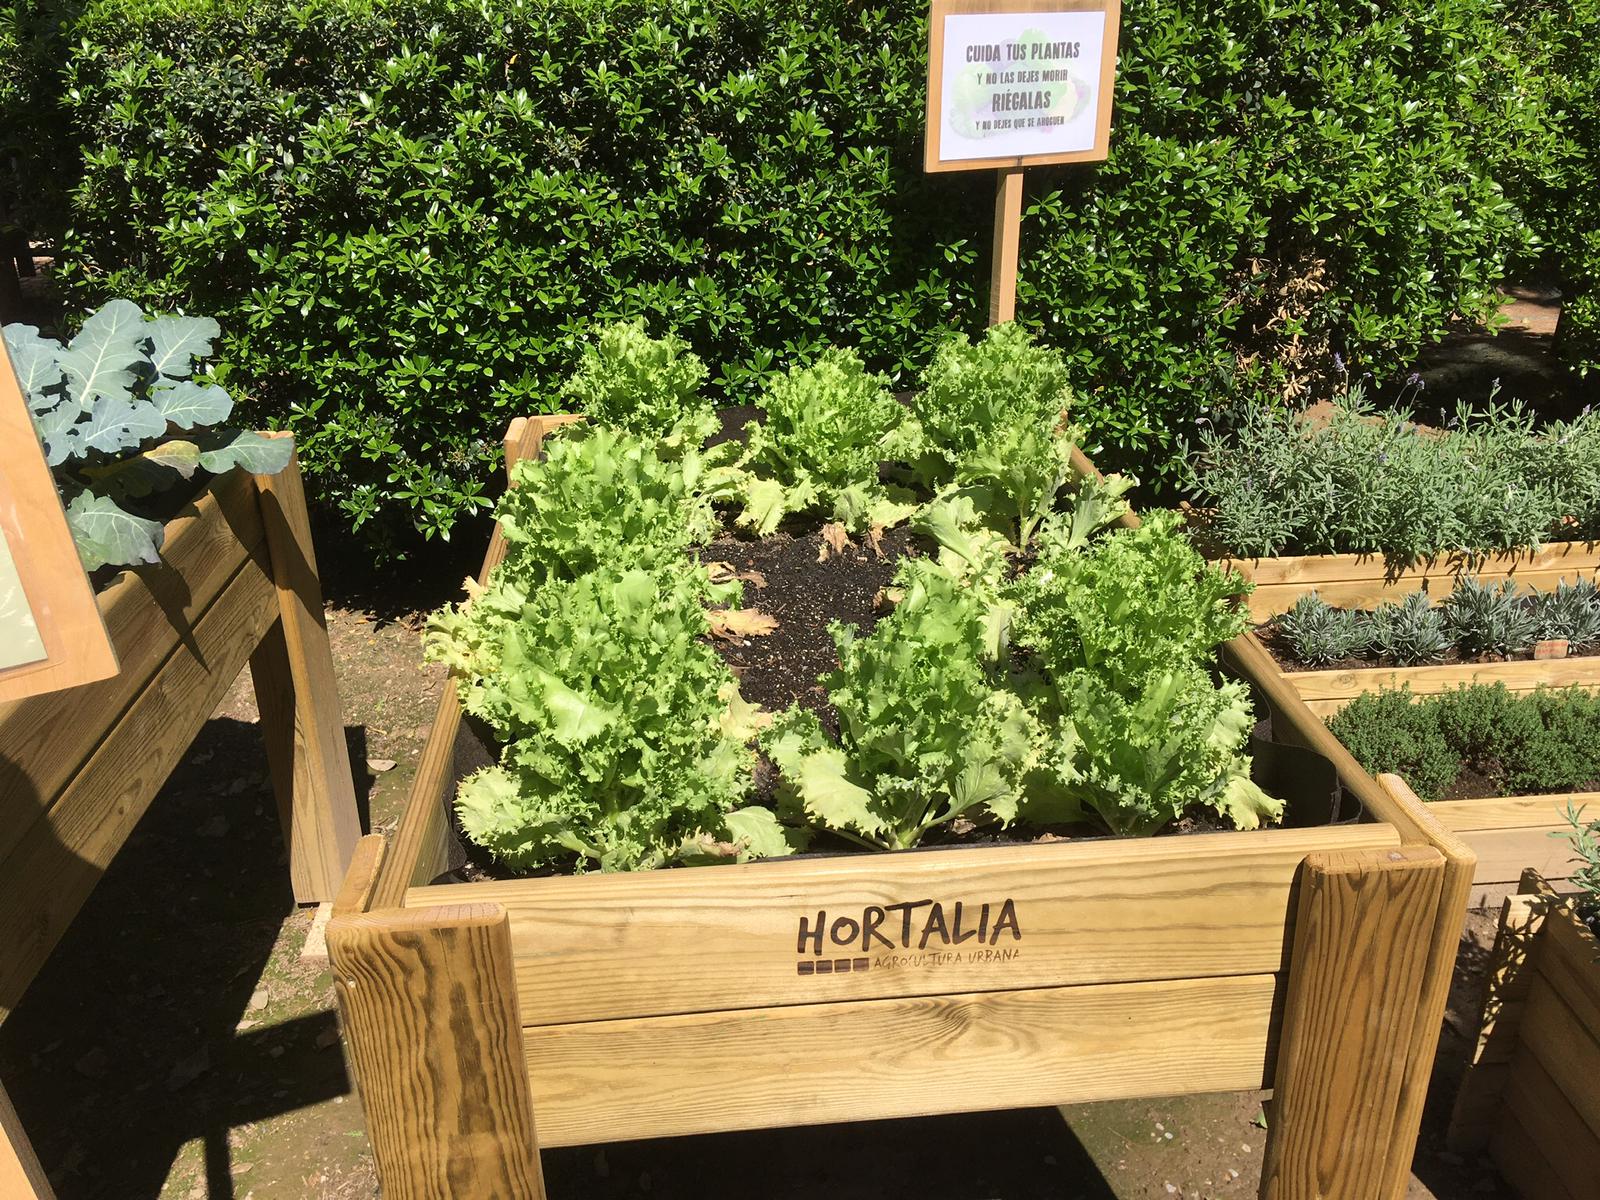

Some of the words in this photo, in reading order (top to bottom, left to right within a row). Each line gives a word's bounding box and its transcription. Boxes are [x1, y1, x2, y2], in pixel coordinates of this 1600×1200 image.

[966, 44, 1001, 63] CUIDA
[1007, 43, 1027, 61] TUS
[1031, 42, 1080, 60] PLANTAS
[977, 73, 982, 85] Y
[986, 72, 997, 85] NO
[1000, 71, 1015, 84] LAS
[1017, 70, 1039, 83] DEJES
[992, 89, 1051, 112] RIÉGALAS
[993, 119, 1011, 129] DEJES
[1014, 118, 1025, 129] QUE
[1027, 117, 1035, 127] SE
[797, 898, 1022, 956] HORTALIA
[969, 948, 1022, 964] URBANA
